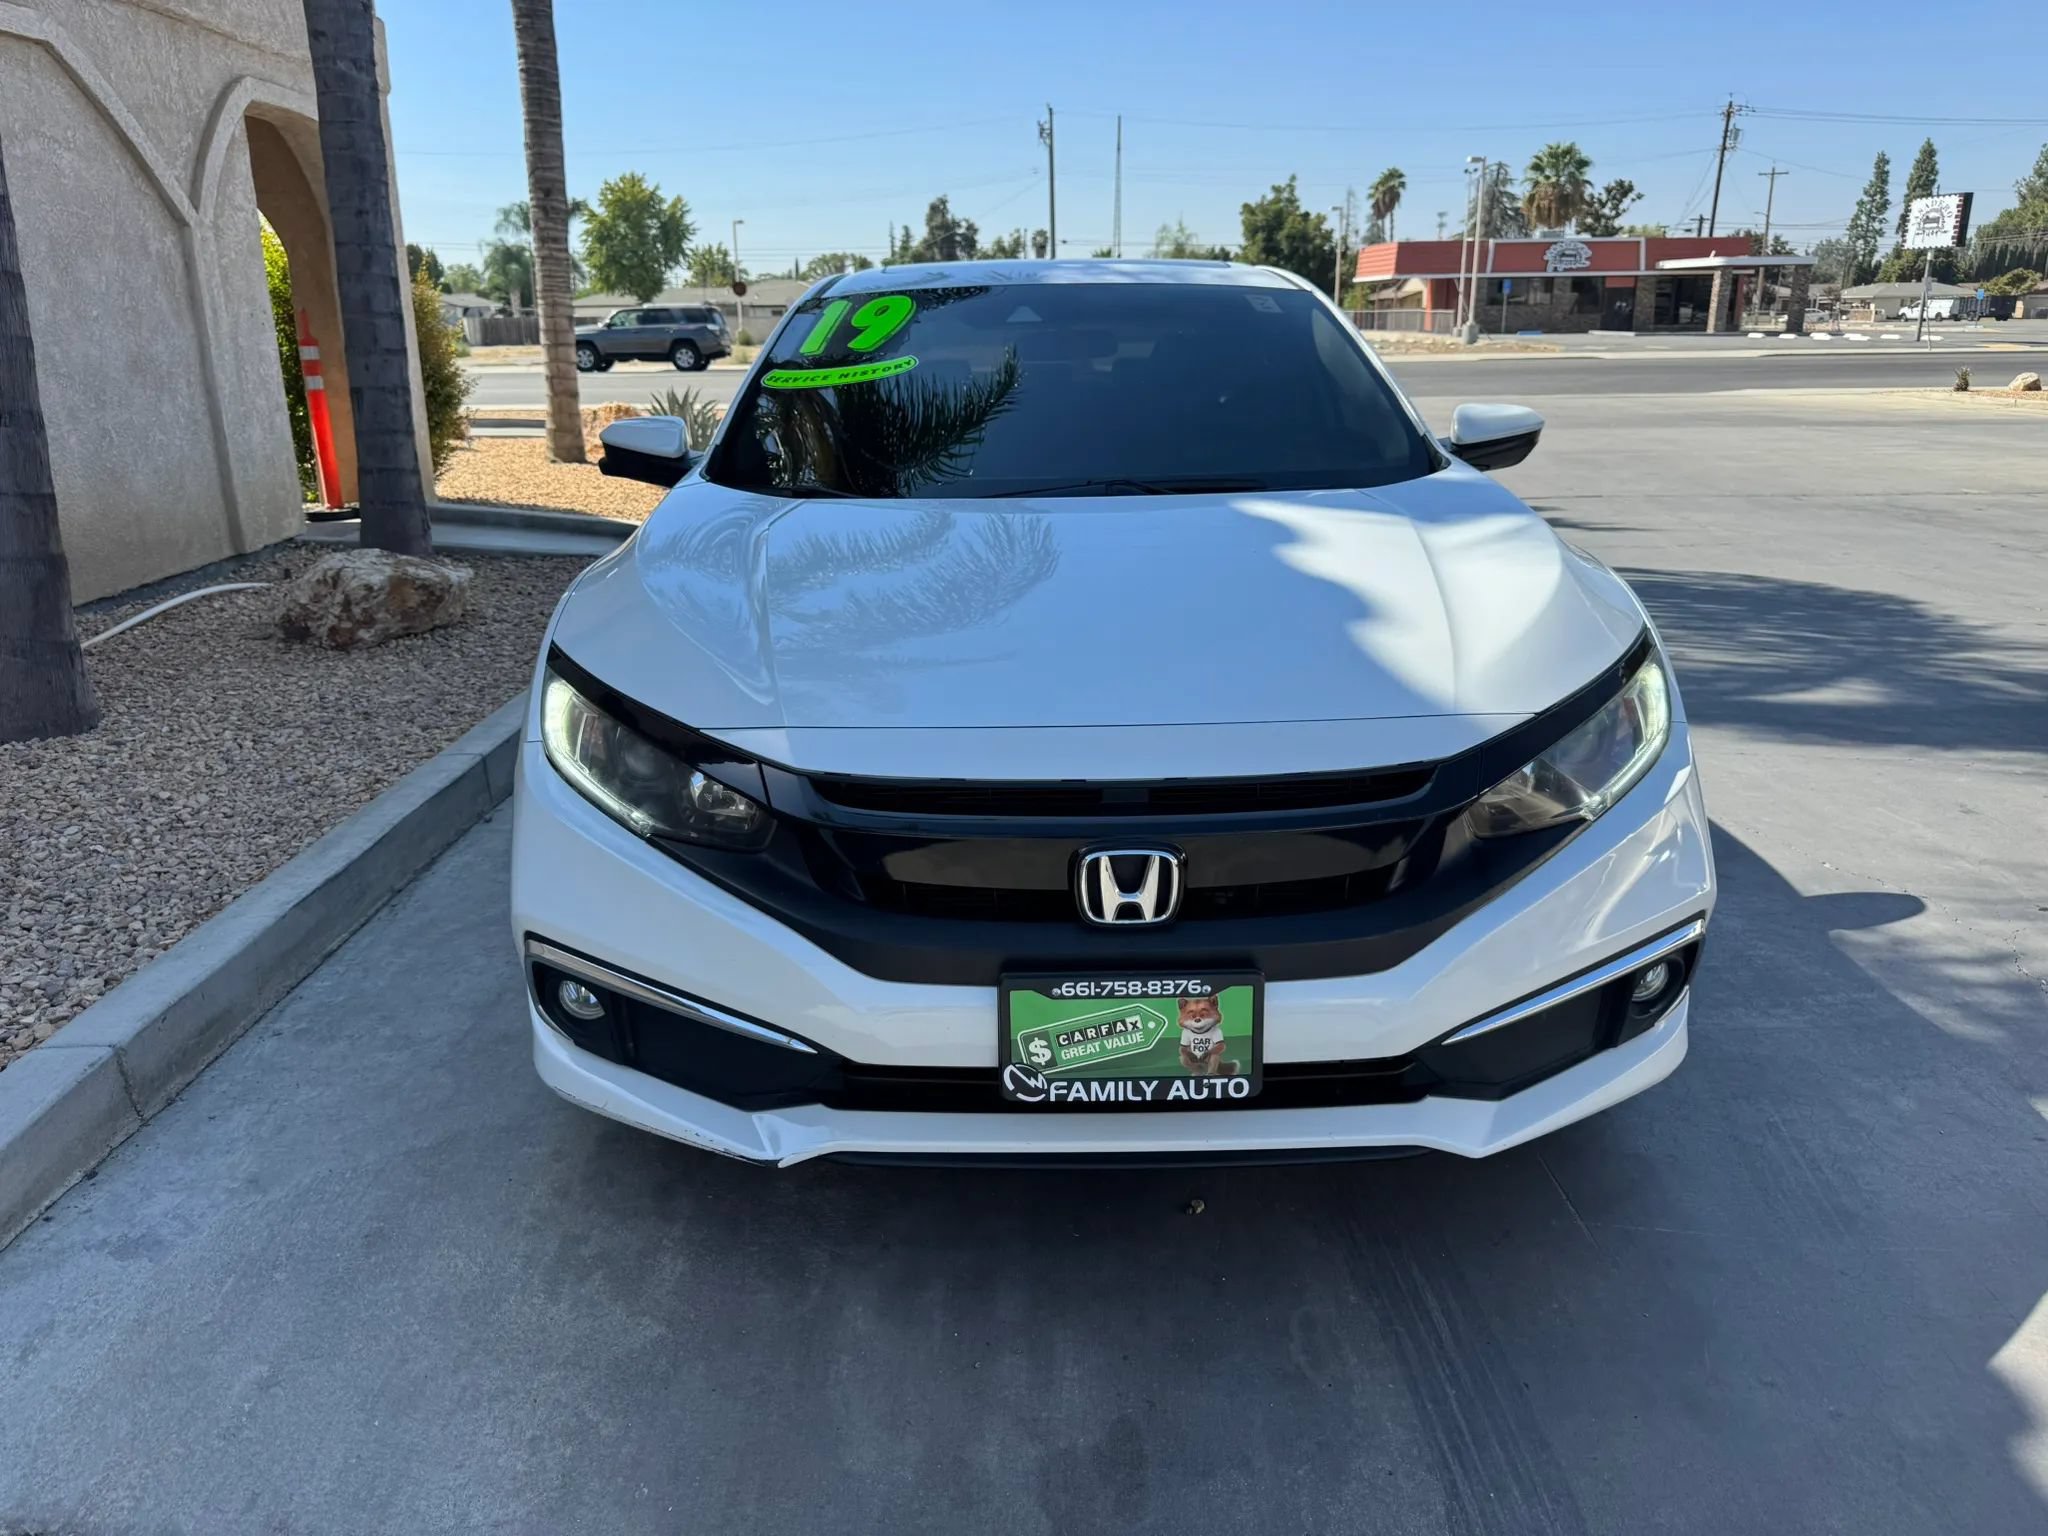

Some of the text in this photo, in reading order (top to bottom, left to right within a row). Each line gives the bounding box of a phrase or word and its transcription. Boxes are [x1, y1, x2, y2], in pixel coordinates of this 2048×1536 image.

[799, 294, 917, 356] 19
[766, 359, 913, 384] SERVICE HISTORY
[1060, 979, 1202, 997] 661-758-8376
[1056, 1016, 1144, 1047] CARFAX
[1192, 1037, 1211, 1045] CAR
[1061, 1032, 1145, 1061] GREAT VALUE
[1192, 1045, 1211, 1053] FOX
[1050, 1077, 1250, 1102] FAMILY AUTO
